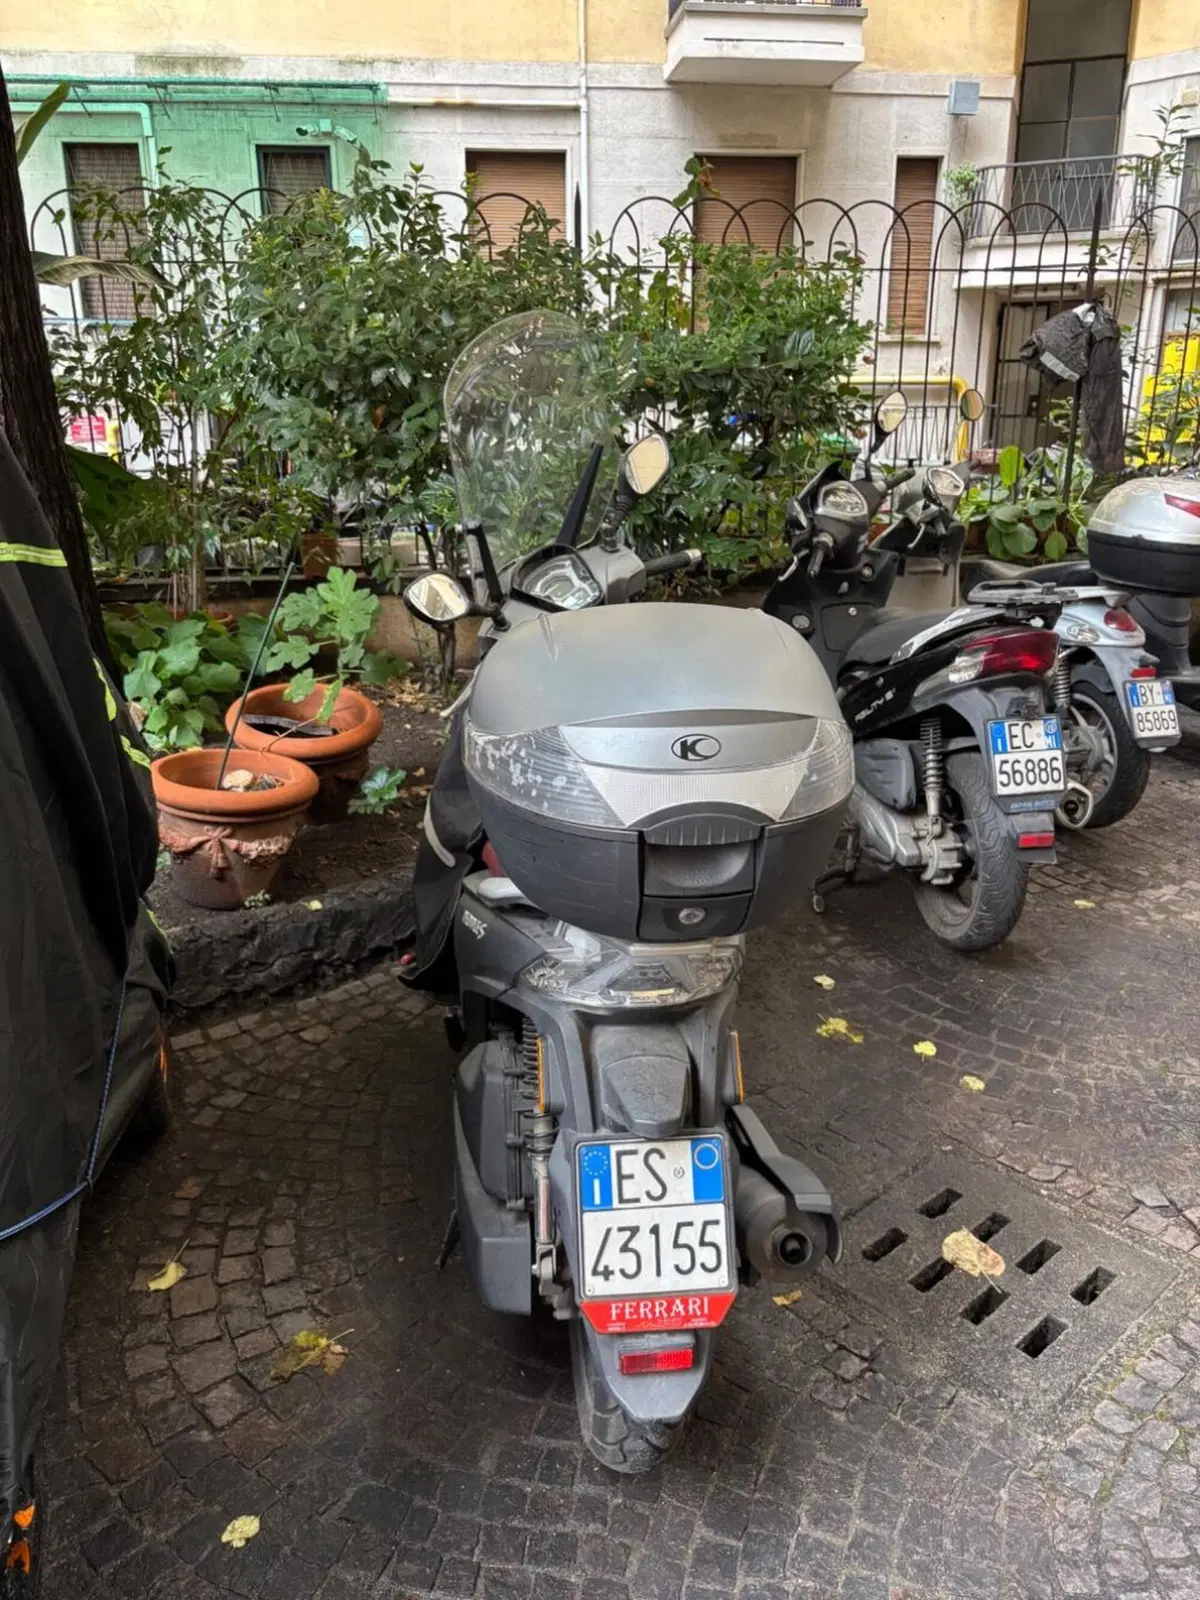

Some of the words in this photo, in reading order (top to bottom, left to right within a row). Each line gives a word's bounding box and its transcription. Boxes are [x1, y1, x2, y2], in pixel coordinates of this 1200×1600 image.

[1139, 684, 1156, 706] BY
[1136, 709, 1177, 733] 85869
[998, 738, 1002, 752] I
[1007, 722, 1035, 751] EC
[998, 757, 1062, 787] 56886
[593, 1178, 601, 1206] I
[615, 1147, 668, 1205] ES
[590, 1219, 723, 1283] 43155
[610, 1296, 710, 1321] FERRARI
